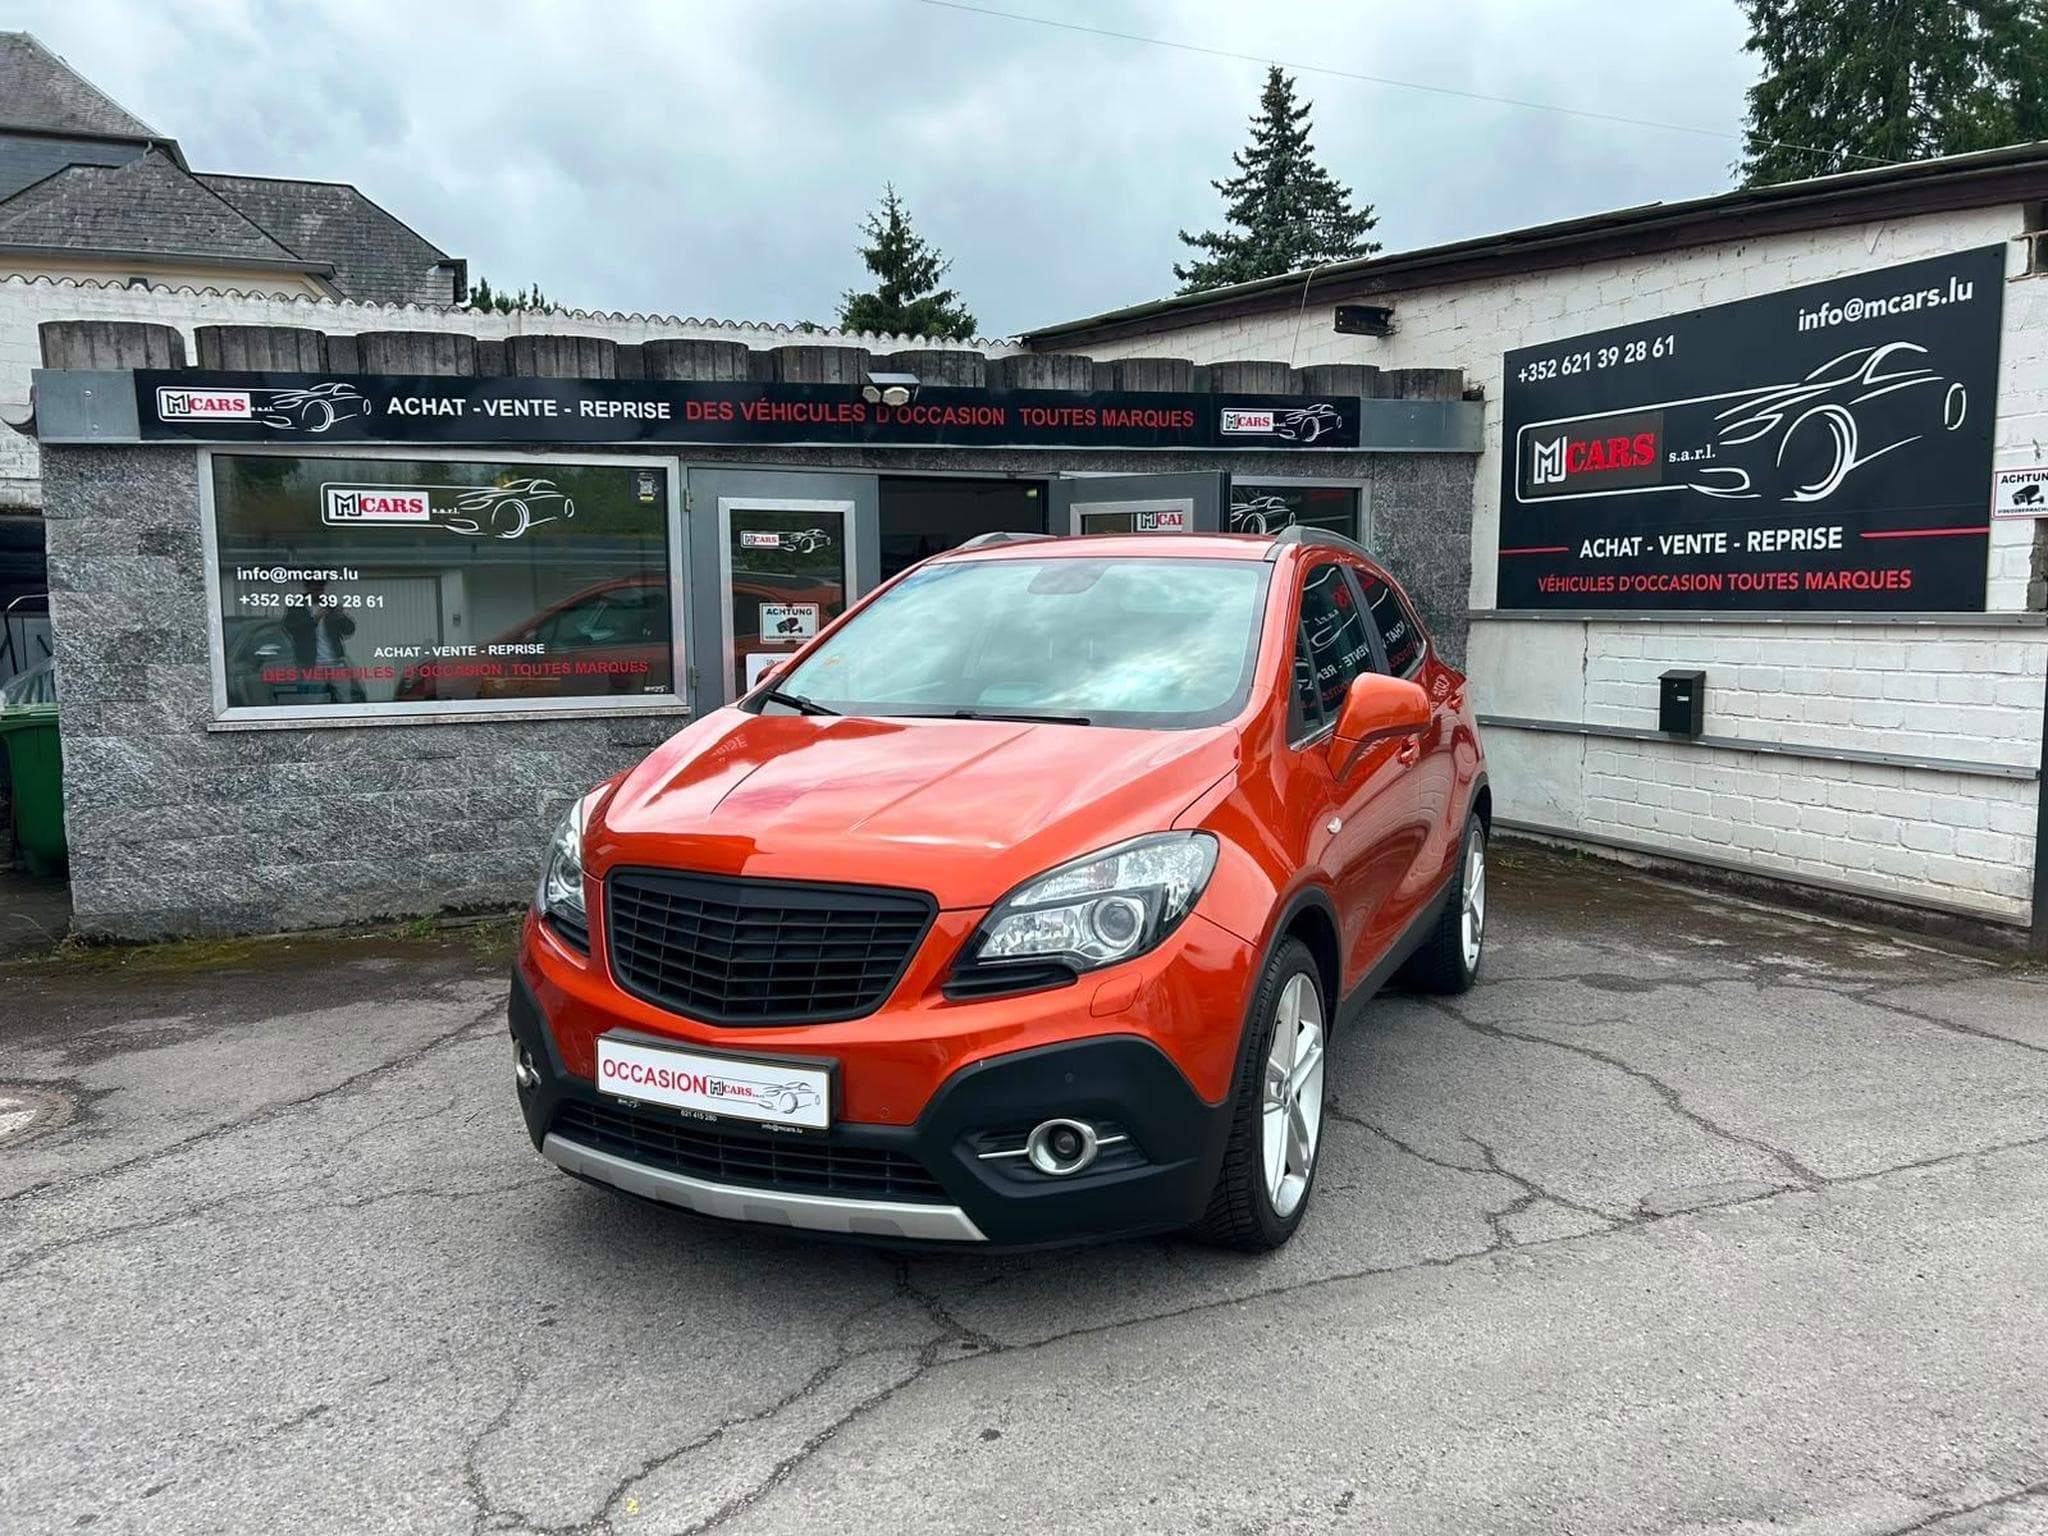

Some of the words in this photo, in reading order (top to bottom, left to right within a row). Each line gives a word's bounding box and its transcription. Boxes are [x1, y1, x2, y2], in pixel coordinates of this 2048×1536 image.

[1797, 276, 1974, 332] info@mcars.lu
[1518, 358, 1557, 384] +352
[1560, 351, 1591, 376] 621
[1597, 346, 1619, 369] 39
[1624, 341, 1647, 364] 28
[1652, 334, 1675, 358] 61
[386, 396, 466, 417] ACHAT
[580, 400, 671, 419] REPRISE
[686, 401, 735, 421] DES
[739, 397, 866, 423] VÉHICULES
[1019, 407, 1097, 427] TOUTES
[1102, 408, 1195, 428] MARQUES
[1579, 536, 1643, 559] ACHAT
[1658, 532, 1728, 556] VENTE
[1747, 526, 1843, 553] REPRISE
[237, 566, 359, 584] info@mcars.lu
[1538, 573, 1616, 593] VÉHICULES
[1618, 573, 1722, 592] D'OCCASION
[1728, 571, 1799, 591] TOUTES
[1805, 569, 1913, 590] MARQUES
[239, 593, 280, 607] +352
[284, 593, 313, 607] 621
[318, 594, 338, 608] 39
[342, 594, 362, 608] 28
[366, 595, 384, 608] 61
[766, 607, 813, 616] ACHTUNG
[374, 646, 421, 658] ACHAT
[432, 645, 477, 657] VENTE
[488, 643, 546, 655] REPRISE
[511, 661, 571, 677] TOUTES
[575, 660, 649, 675] MARQUES
[602, 1058, 707, 1095] OCCASION
